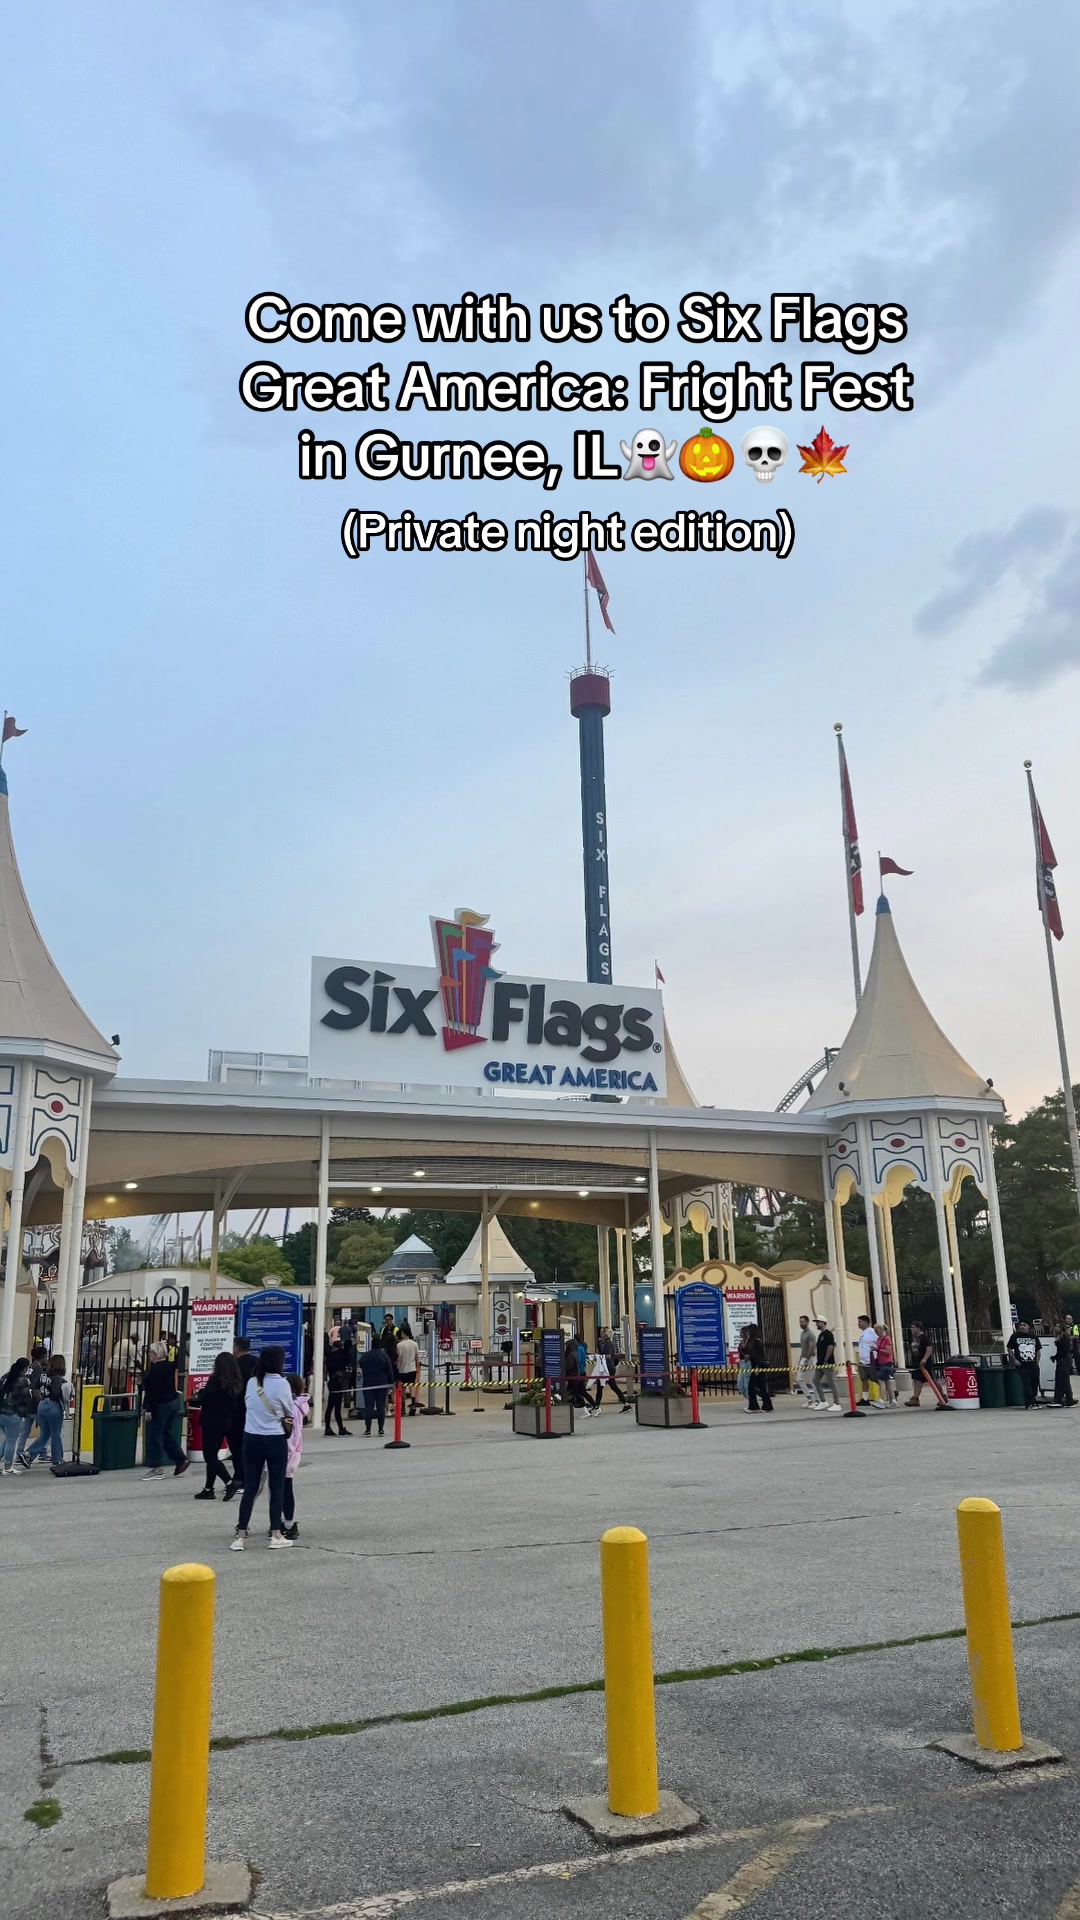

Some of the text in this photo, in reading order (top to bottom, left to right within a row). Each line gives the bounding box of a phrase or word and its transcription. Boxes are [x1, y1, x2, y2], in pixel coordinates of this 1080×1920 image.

[595, 811, 610, 977] SIX FLAGS
[320, 966, 440, 1037] Six
[483, 1060, 659, 1092] GREAT AMERICA
[193, 1303, 235, 1312] WARNING
[726, 1292, 756, 1300] WARNING
